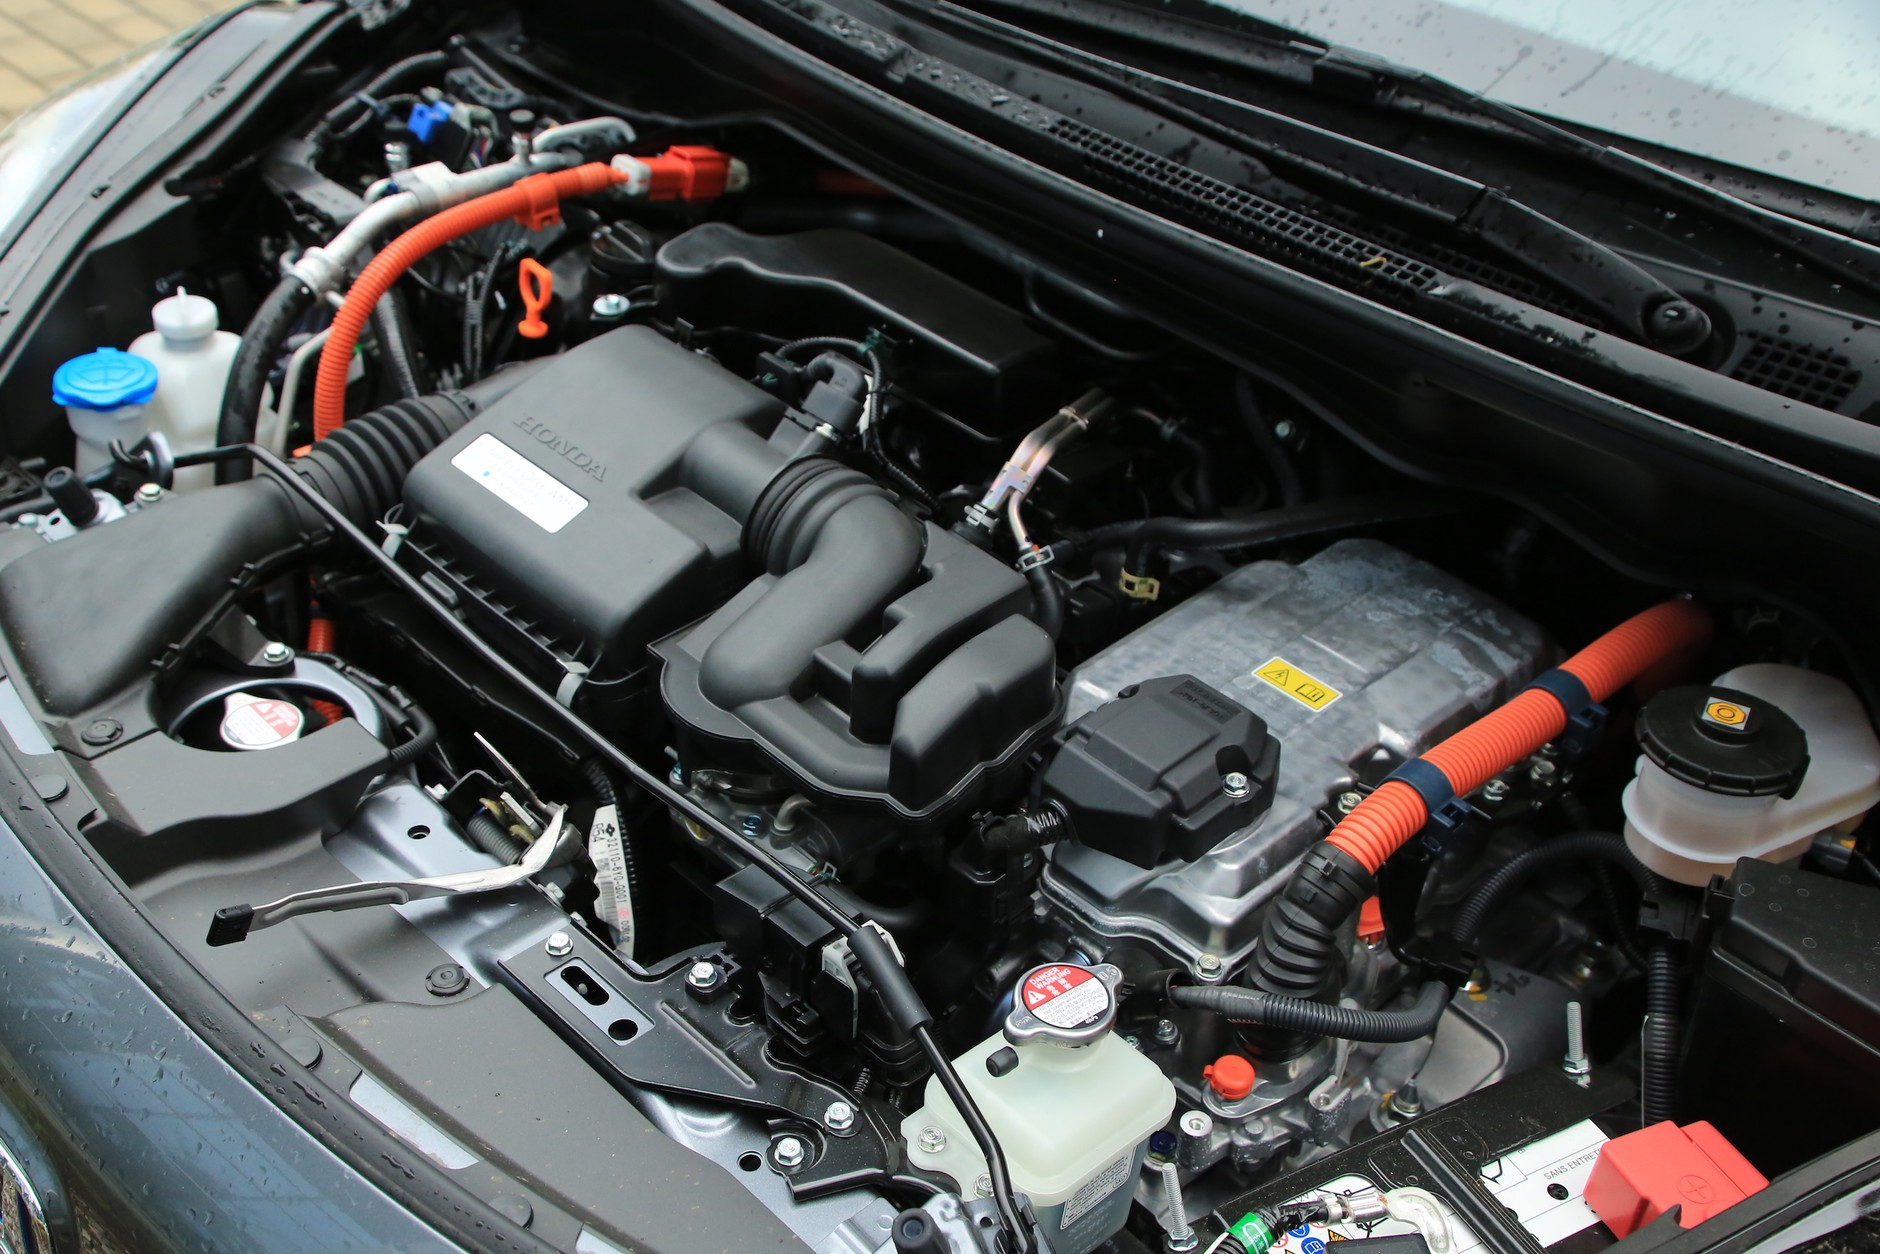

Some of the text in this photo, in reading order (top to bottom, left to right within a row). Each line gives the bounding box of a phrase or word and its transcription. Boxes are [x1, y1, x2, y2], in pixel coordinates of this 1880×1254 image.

[512, 413, 608, 483] HONDA
[1029, 966, 1060, 985] DANGER
[1034, 968, 1072, 990] WARNUNG
[1543, 1149, 1600, 1180] SANS ENTRET
